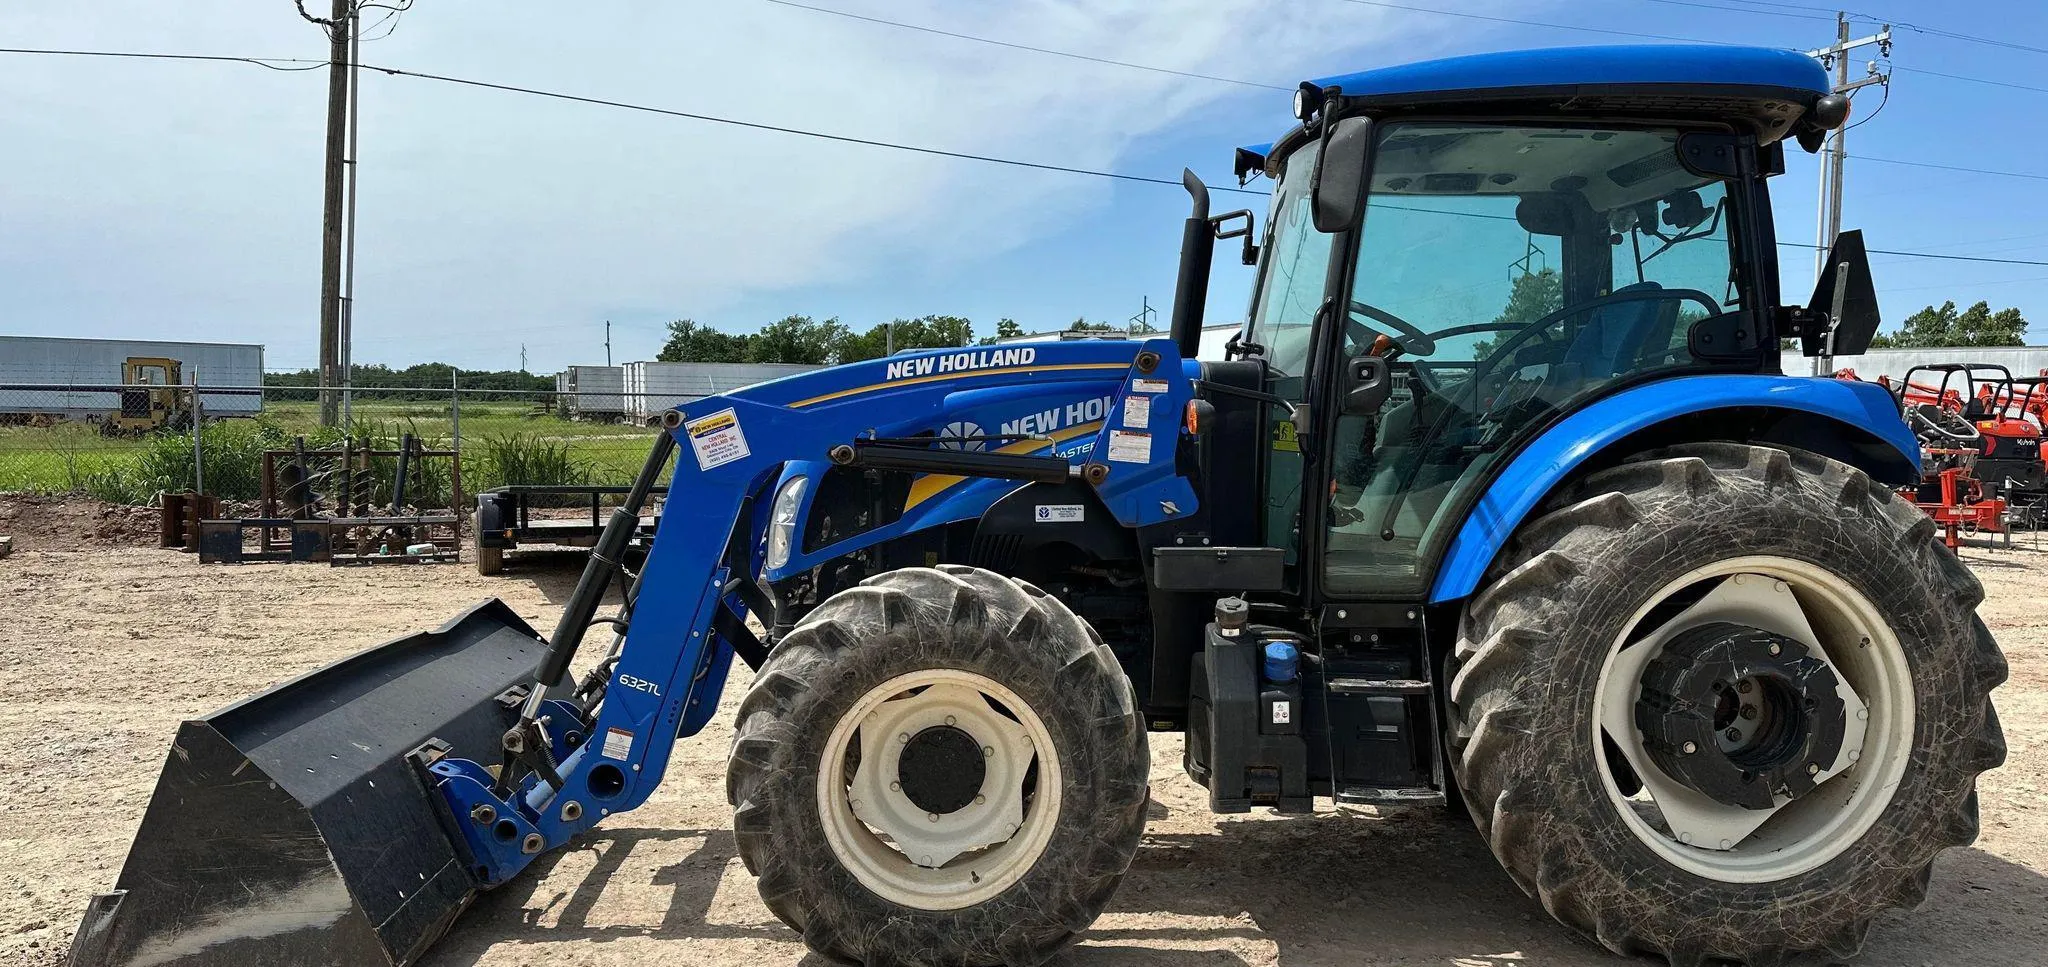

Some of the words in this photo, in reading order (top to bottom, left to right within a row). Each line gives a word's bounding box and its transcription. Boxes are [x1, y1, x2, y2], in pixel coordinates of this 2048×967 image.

[887, 357, 935, 380] NEW
[939, 348, 1035, 372] HOLLAND
[1002, 408, 1060, 443] NEW
[708, 433, 727, 443] CENTRAL
[711, 438, 729, 448] HOLLAND
[619, 674, 661, 697] 632TL
